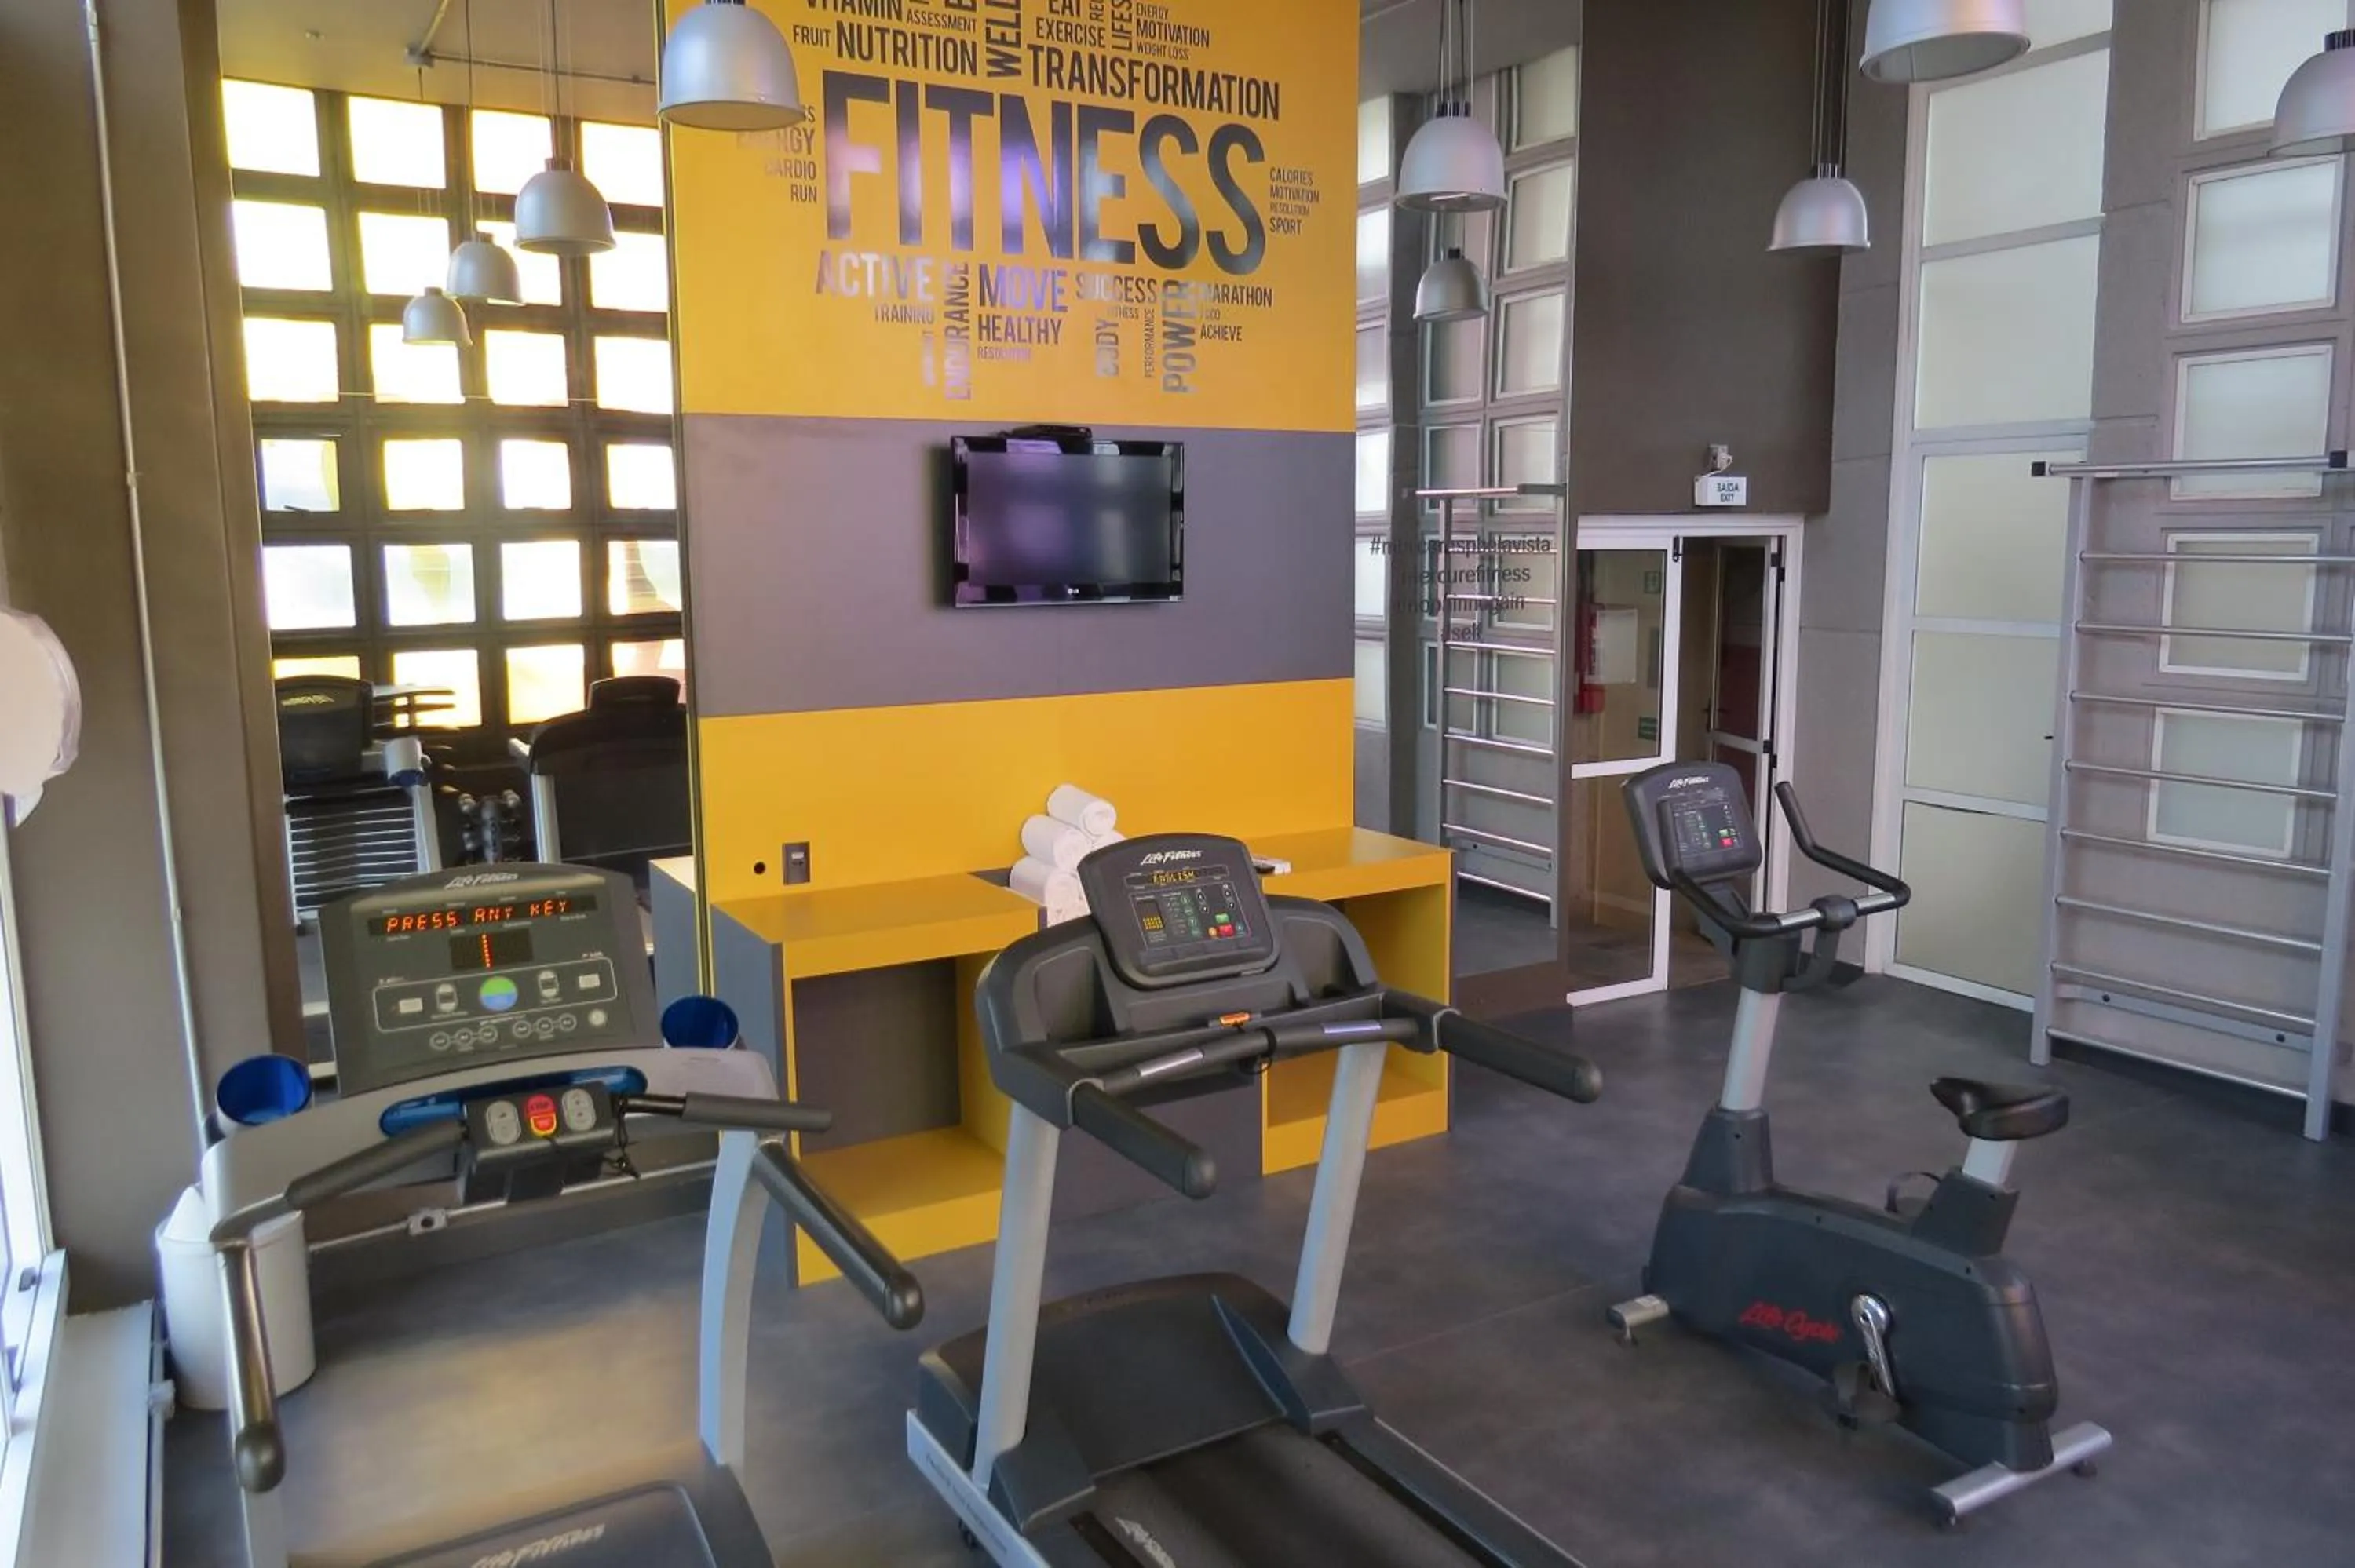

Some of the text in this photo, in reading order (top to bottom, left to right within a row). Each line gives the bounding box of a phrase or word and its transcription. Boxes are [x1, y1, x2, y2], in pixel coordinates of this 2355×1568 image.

[806, 0, 902, 21] AMIN
[906, 12, 977, 33] ASSESSMENT
[1136, 3, 1169, 20] ENERGY
[793, 24, 831, 47] FRUIT
[836, 20, 977, 76] NUTRITION
[1035, 17, 1105, 49] EXERCISE
[1136, 19, 1210, 49] MOTIVATION
[1136, 41, 1189, 60] WEIGHT LOSS
[1027, 44, 1280, 121] TRANSFORMATION
[823, 70, 1267, 276] FITNESS
[1269, 166, 1313, 187] CALORIES
[790, 184, 817, 204] RUN
[1269, 216, 1302, 236] SPORT
[816, 250, 936, 303] ACTIVE
[978, 264, 1068, 313] MOVE
[1075, 272, 1158, 304] SUCCESS
[874, 304, 935, 325] TRAINING
[977, 314, 1062, 346] HEALTHY
[944, 262, 971, 401] ENDURANCE
[1162, 279, 1198, 393] POWER
[1200, 324, 1243, 342] ACHIEVE
[386, 910, 458, 934] PRESS
[474, 906, 513, 924] ANY
[529, 899, 568, 917] KEY
